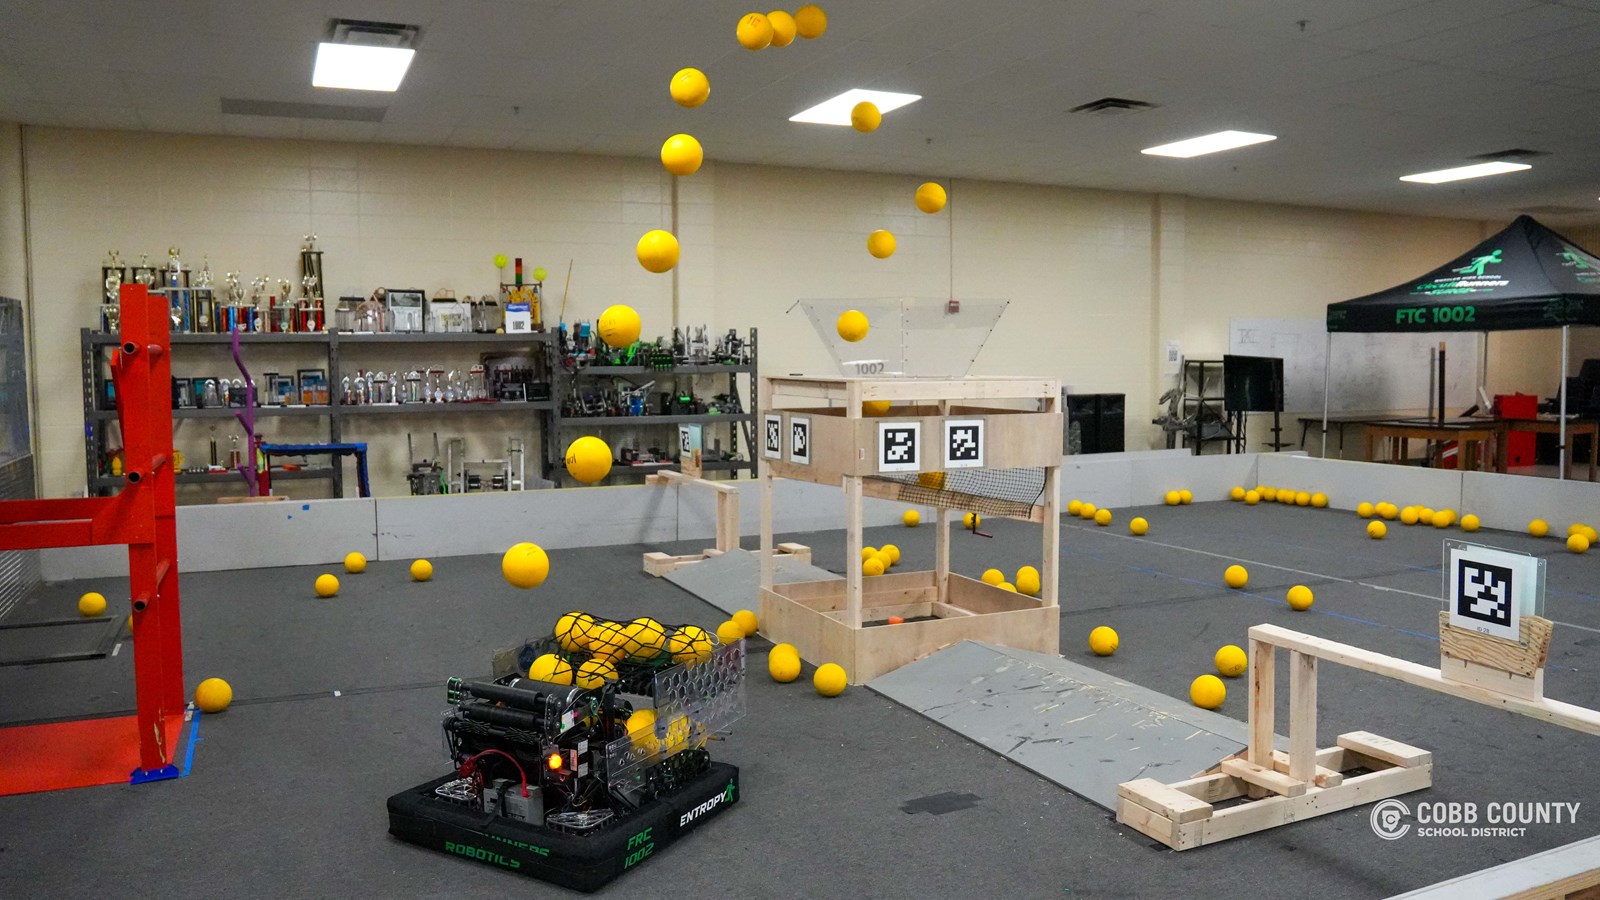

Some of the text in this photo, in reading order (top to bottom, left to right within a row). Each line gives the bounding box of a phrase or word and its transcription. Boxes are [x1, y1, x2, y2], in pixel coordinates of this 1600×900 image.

[1396, 305, 1476, 325] FTC 1002
[855, 362, 885, 375] 1002
[679, 790, 728, 828] ENTROPY
[627, 827, 653, 851] FRC
[624, 843, 655, 870] 1002
